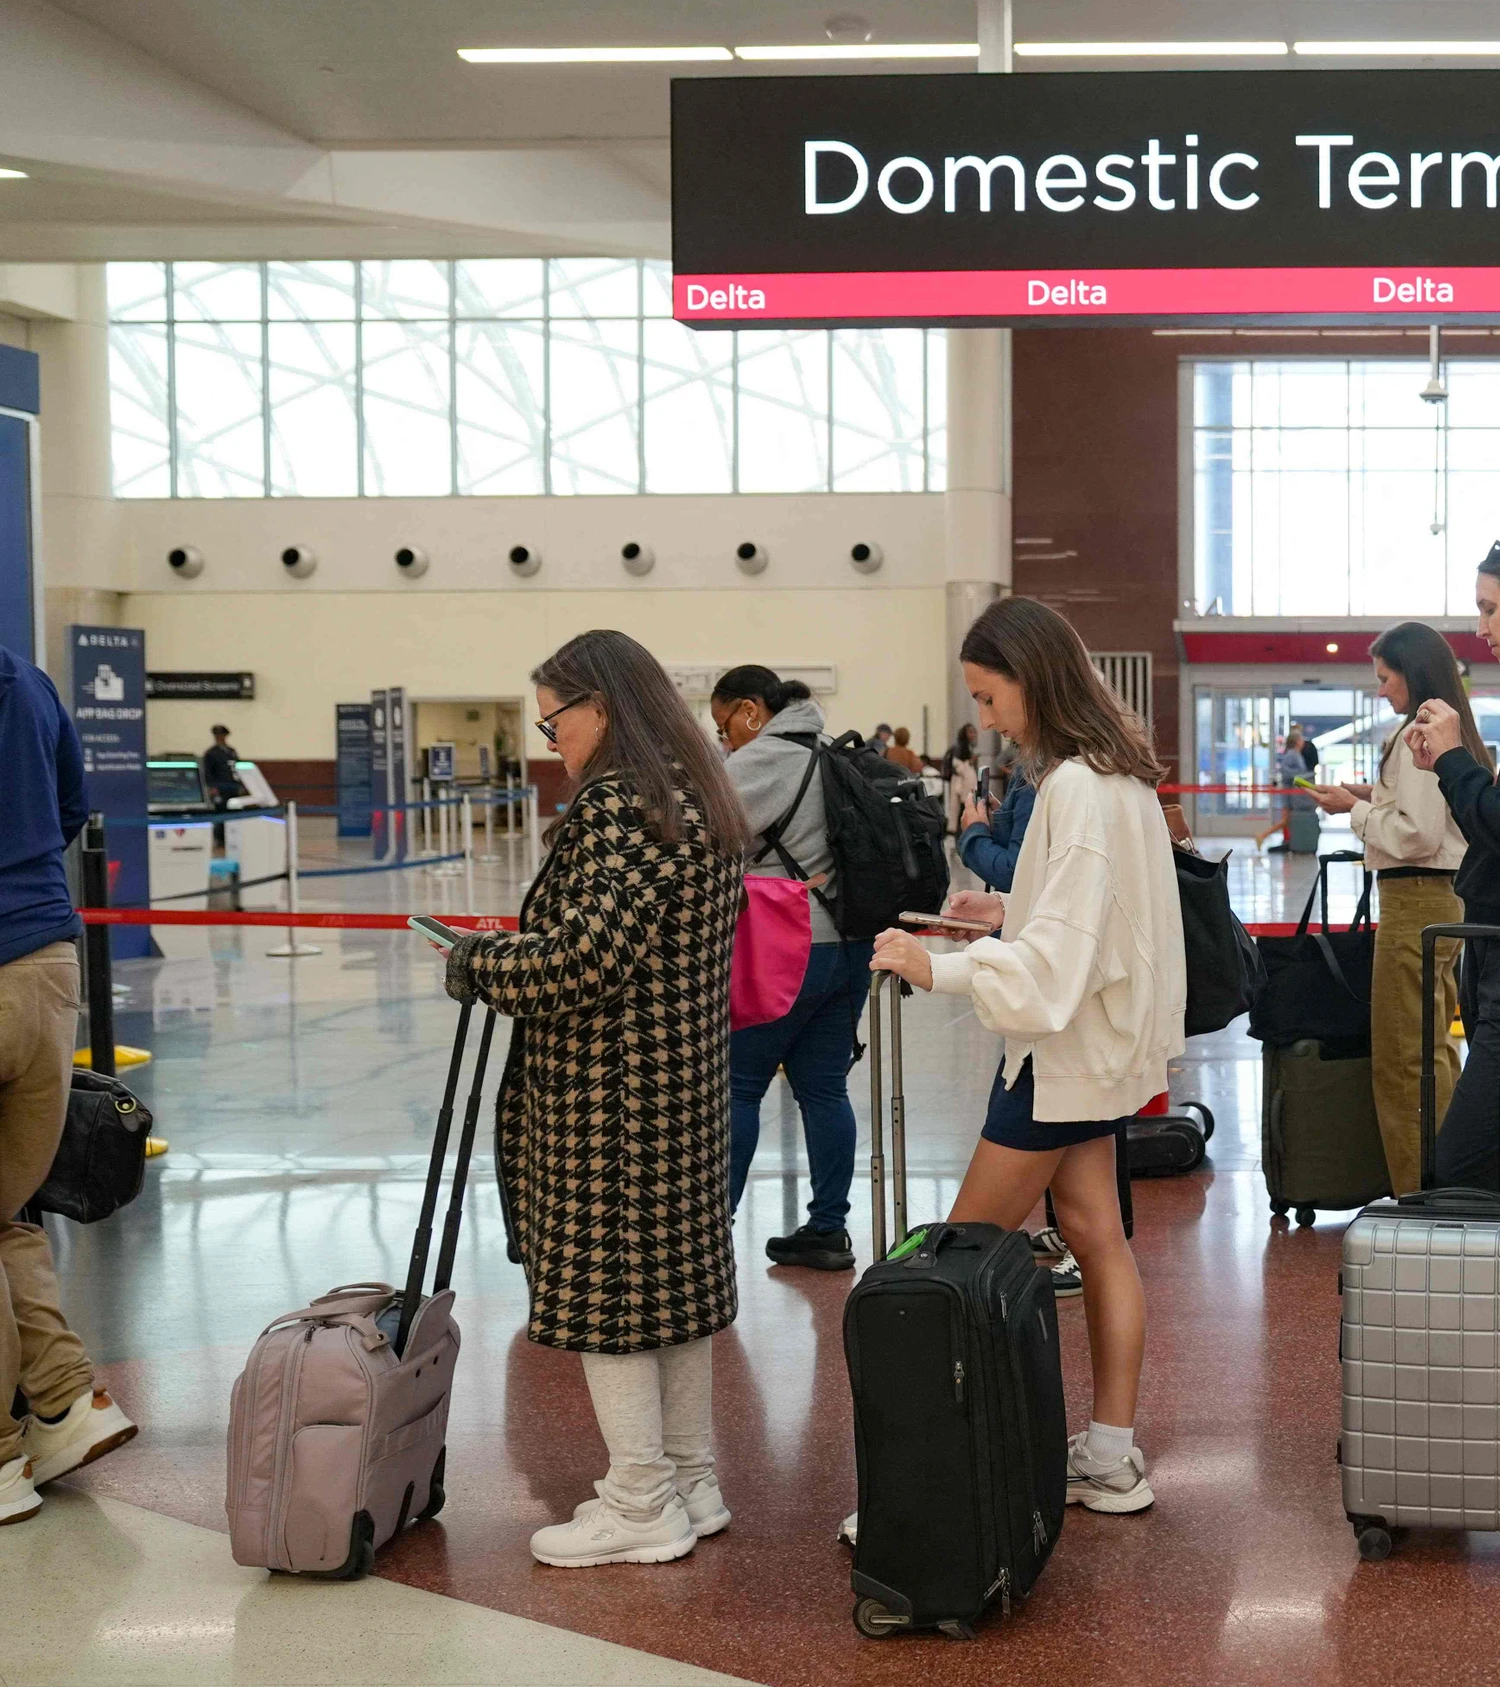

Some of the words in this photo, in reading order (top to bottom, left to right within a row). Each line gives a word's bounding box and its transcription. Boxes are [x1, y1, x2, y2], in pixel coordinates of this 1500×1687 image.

[805, 135, 1259, 214] Domestic
[688, 284, 765, 310] Delta
[1029, 280, 1106, 305] Delta
[1374, 277, 1453, 302] Delta
[90, 635, 128, 647] DELTA
[76, 707, 94, 720] APP
[96, 707, 116, 720] BAG
[117, 707, 143, 720] DROP
[476, 918, 504, 930] ATL
